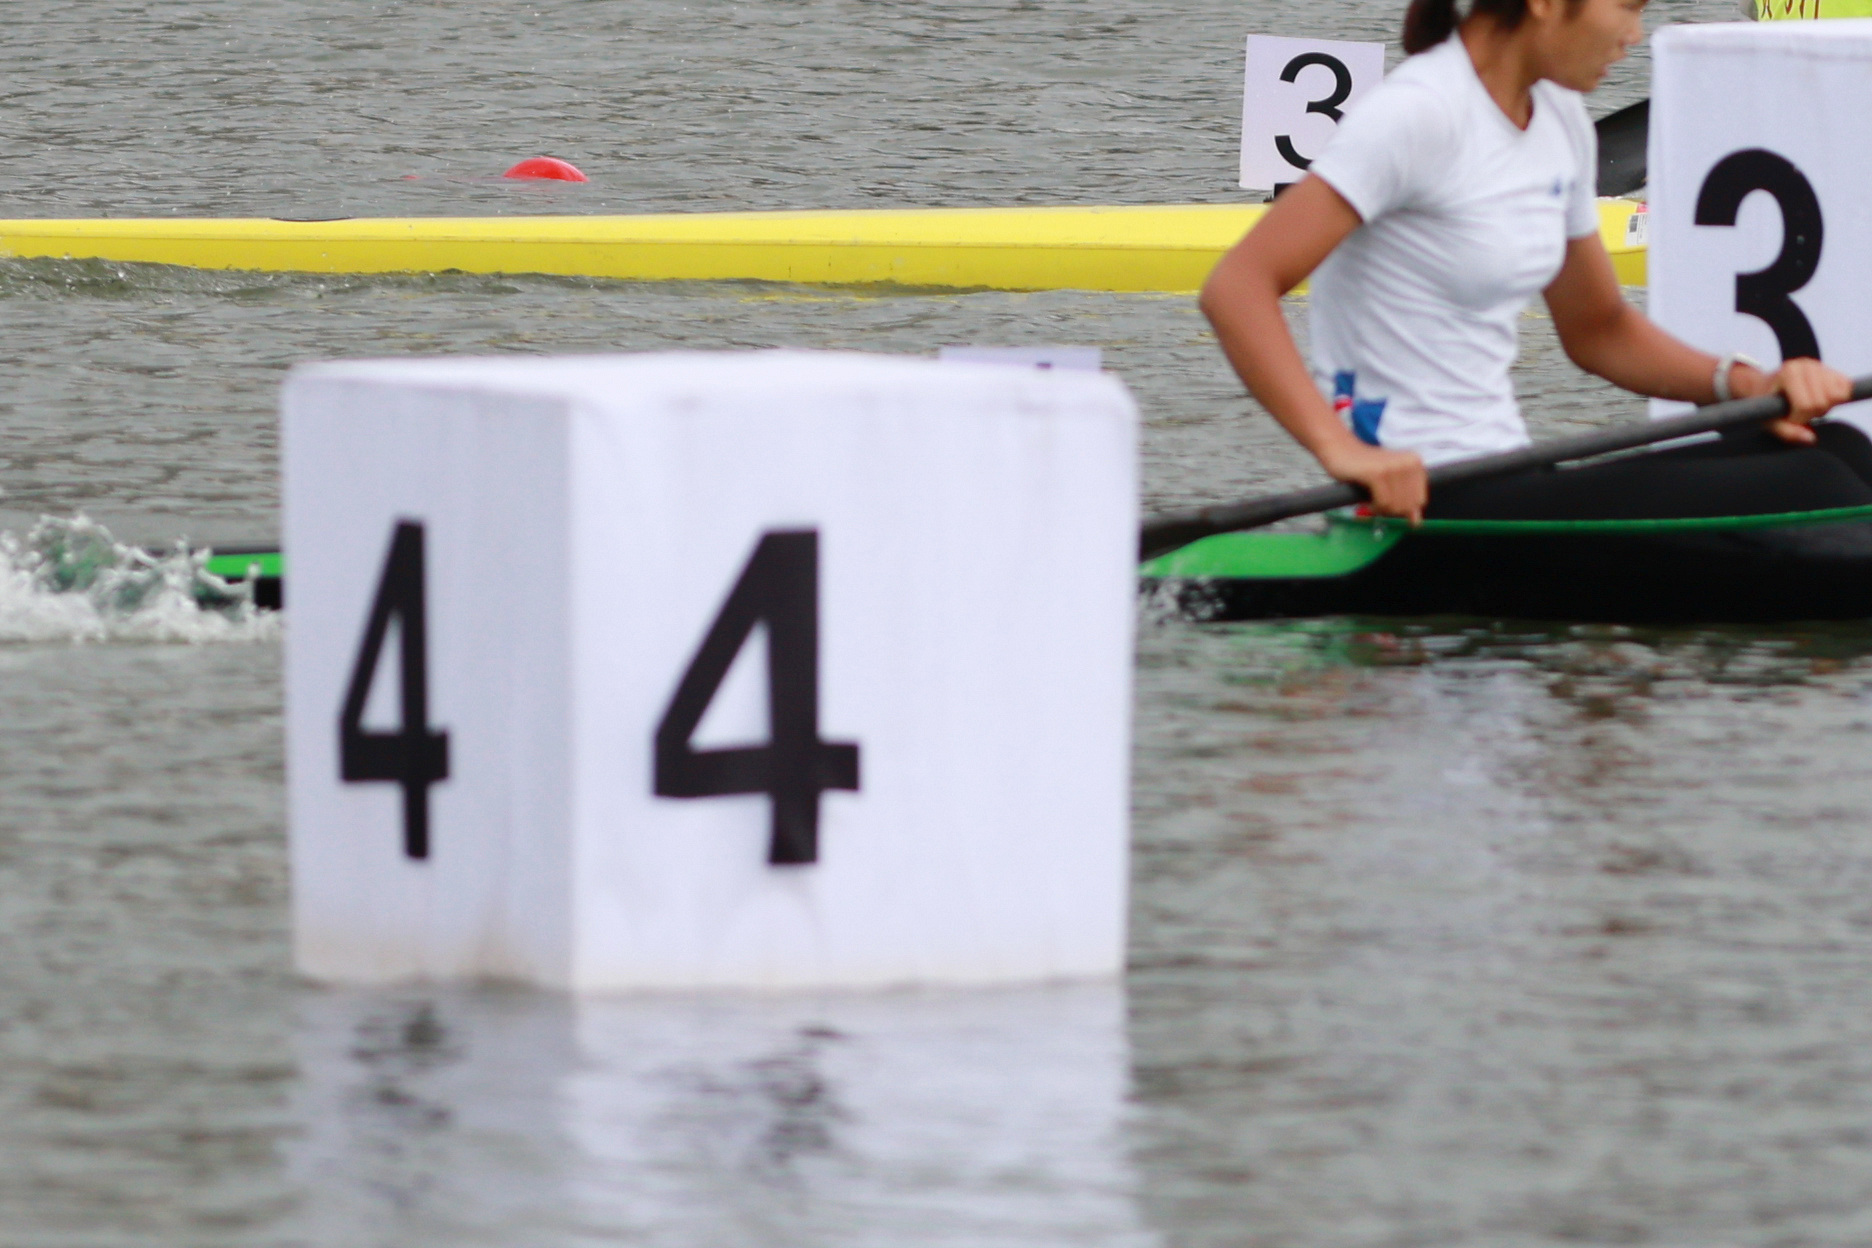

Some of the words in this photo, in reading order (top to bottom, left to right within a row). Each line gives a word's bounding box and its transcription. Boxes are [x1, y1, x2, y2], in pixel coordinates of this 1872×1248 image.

[1275, 52, 1352, 171] 3
[1693, 147, 1823, 362] 3
[339, 518, 450, 860] 4
[652, 527, 861, 866] 4
